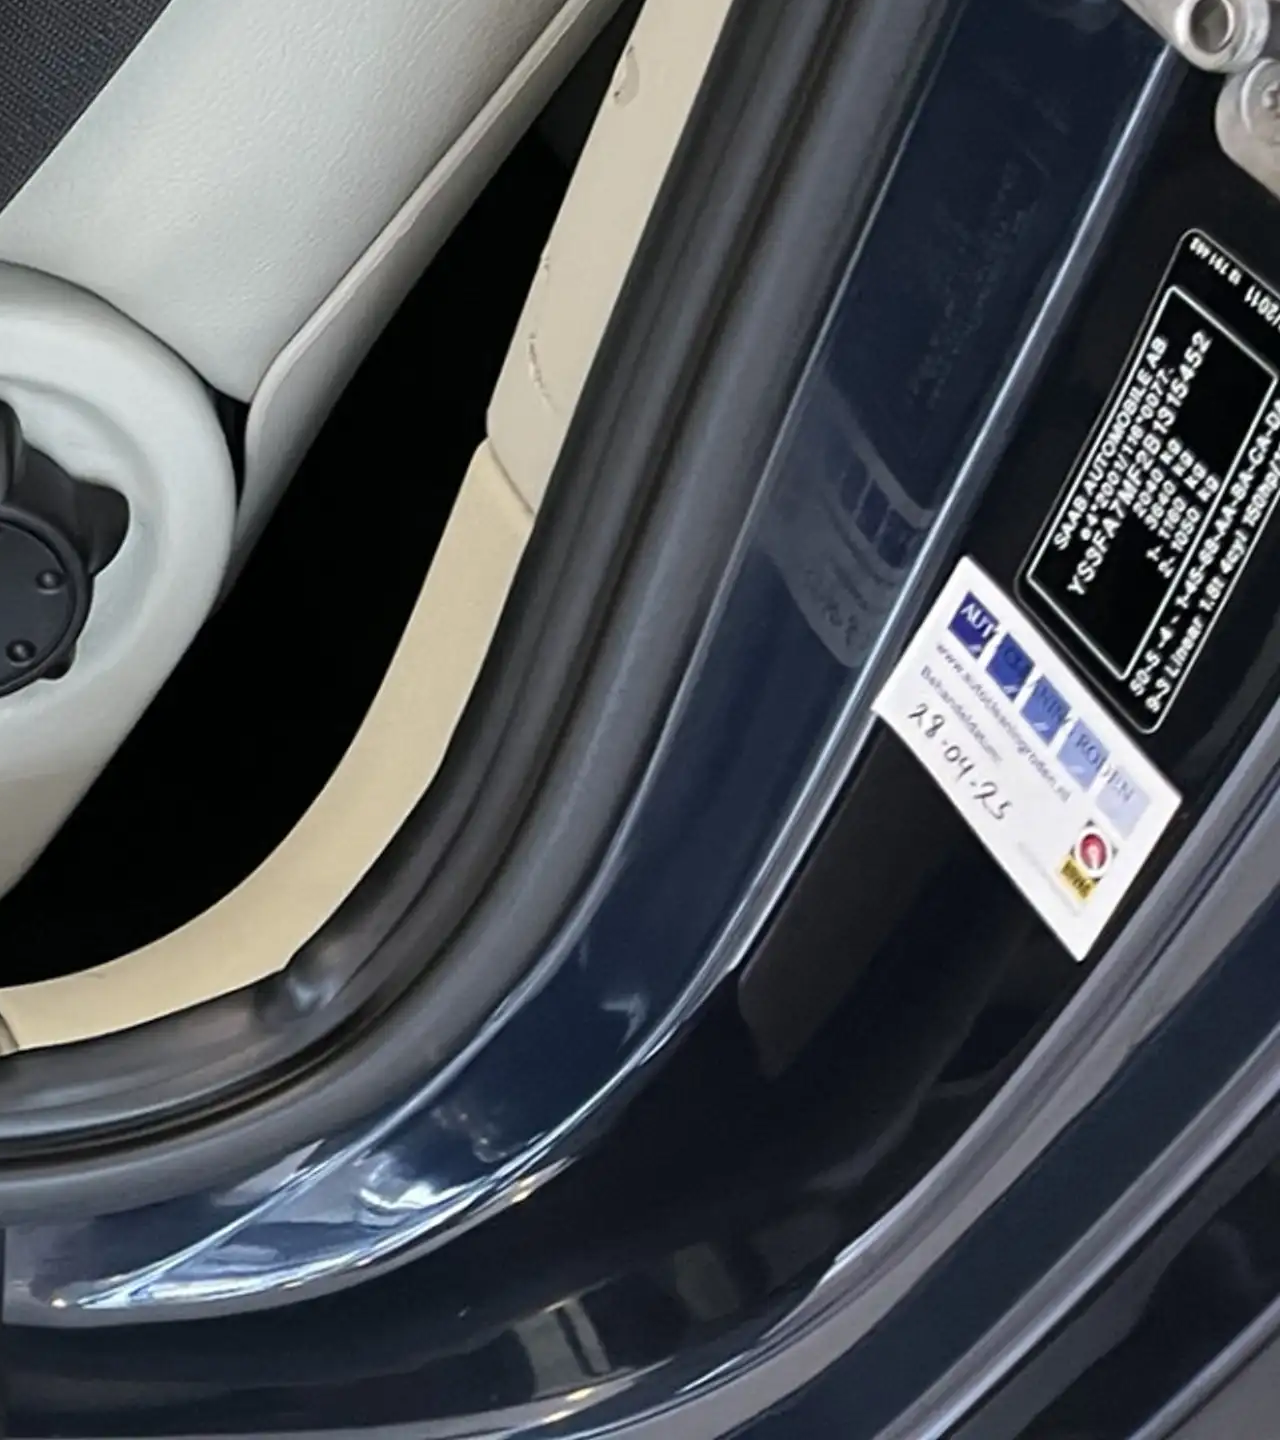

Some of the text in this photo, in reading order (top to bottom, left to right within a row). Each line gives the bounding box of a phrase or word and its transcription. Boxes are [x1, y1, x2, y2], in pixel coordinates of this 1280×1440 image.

[1054, 336, 1168, 550] SAAB AUTOMOBILE AB
[1172, 450, 1195, 477] kg
[1133, 438, 1182, 518] 2040 kg
[1184, 463, 1207, 490] kg
[1196, 474, 1220, 502] kg
[1164, 616, 1204, 678] Linear
